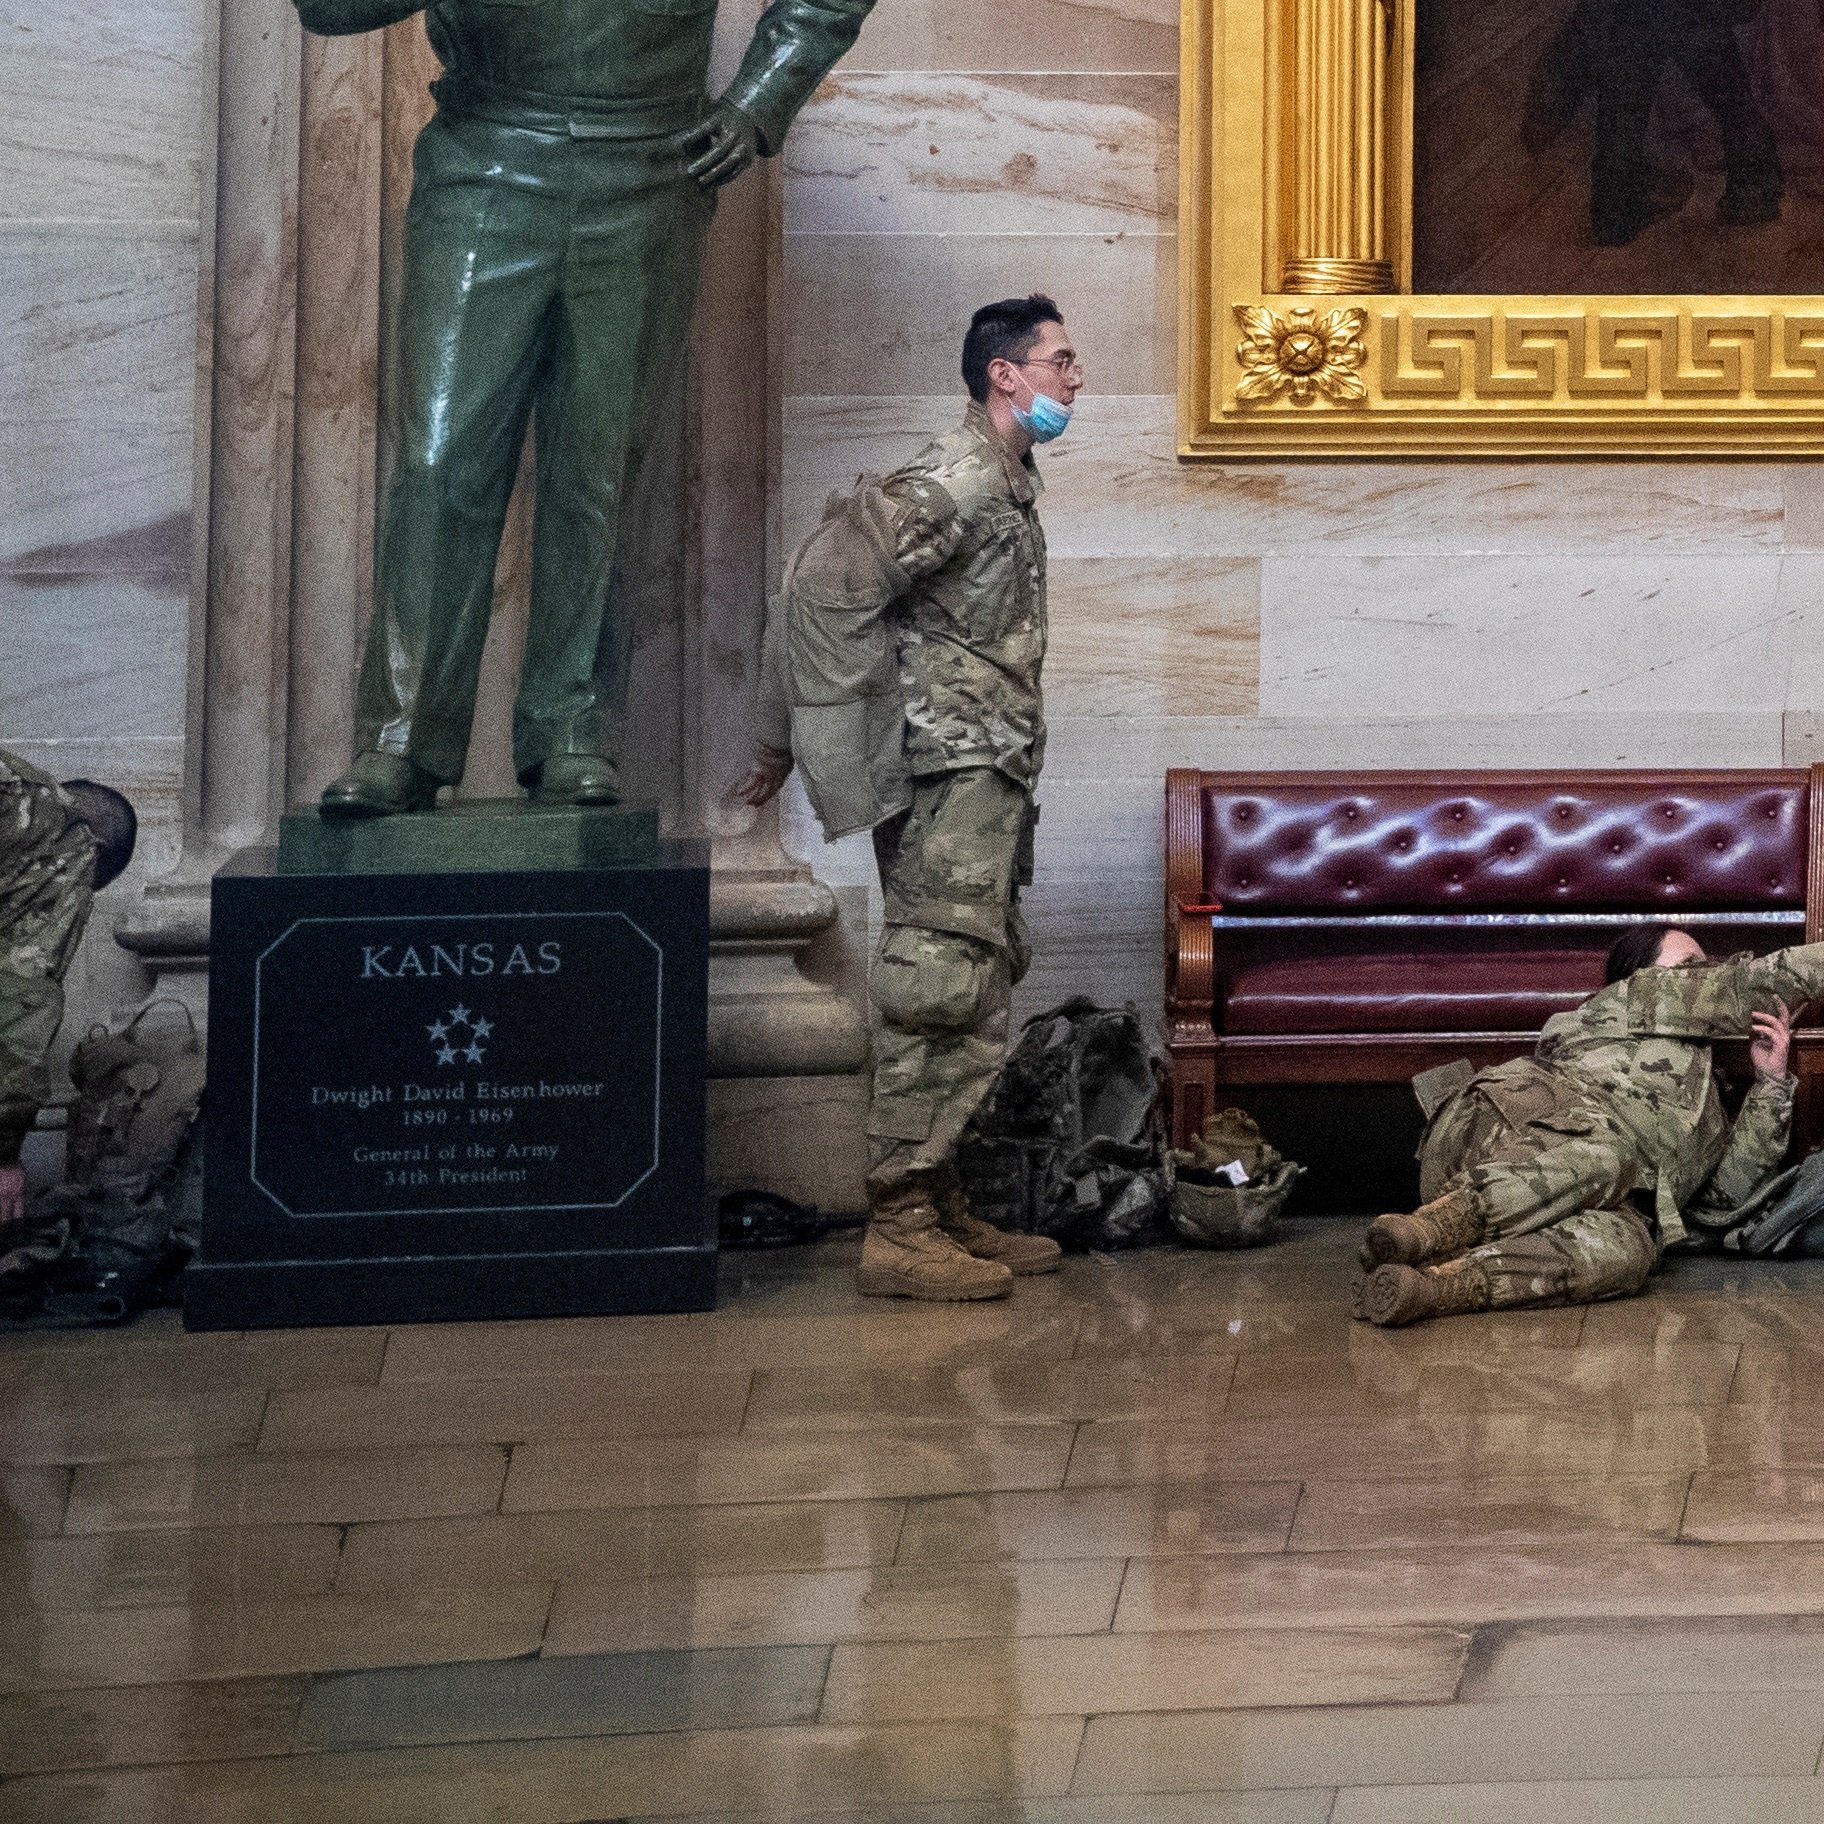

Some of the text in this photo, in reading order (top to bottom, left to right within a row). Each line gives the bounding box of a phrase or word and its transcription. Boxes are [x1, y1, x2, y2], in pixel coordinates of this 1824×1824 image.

[359, 941, 564, 980] KANSAS
[310, 1080, 606, 1110] Dwight David Eisenhower
[402, 1108, 449, 1126] 1890
[469, 1107, 515, 1125] 1969
[353, 1142, 561, 1165] General of the Army
[383, 1166, 529, 1188] 34th President
